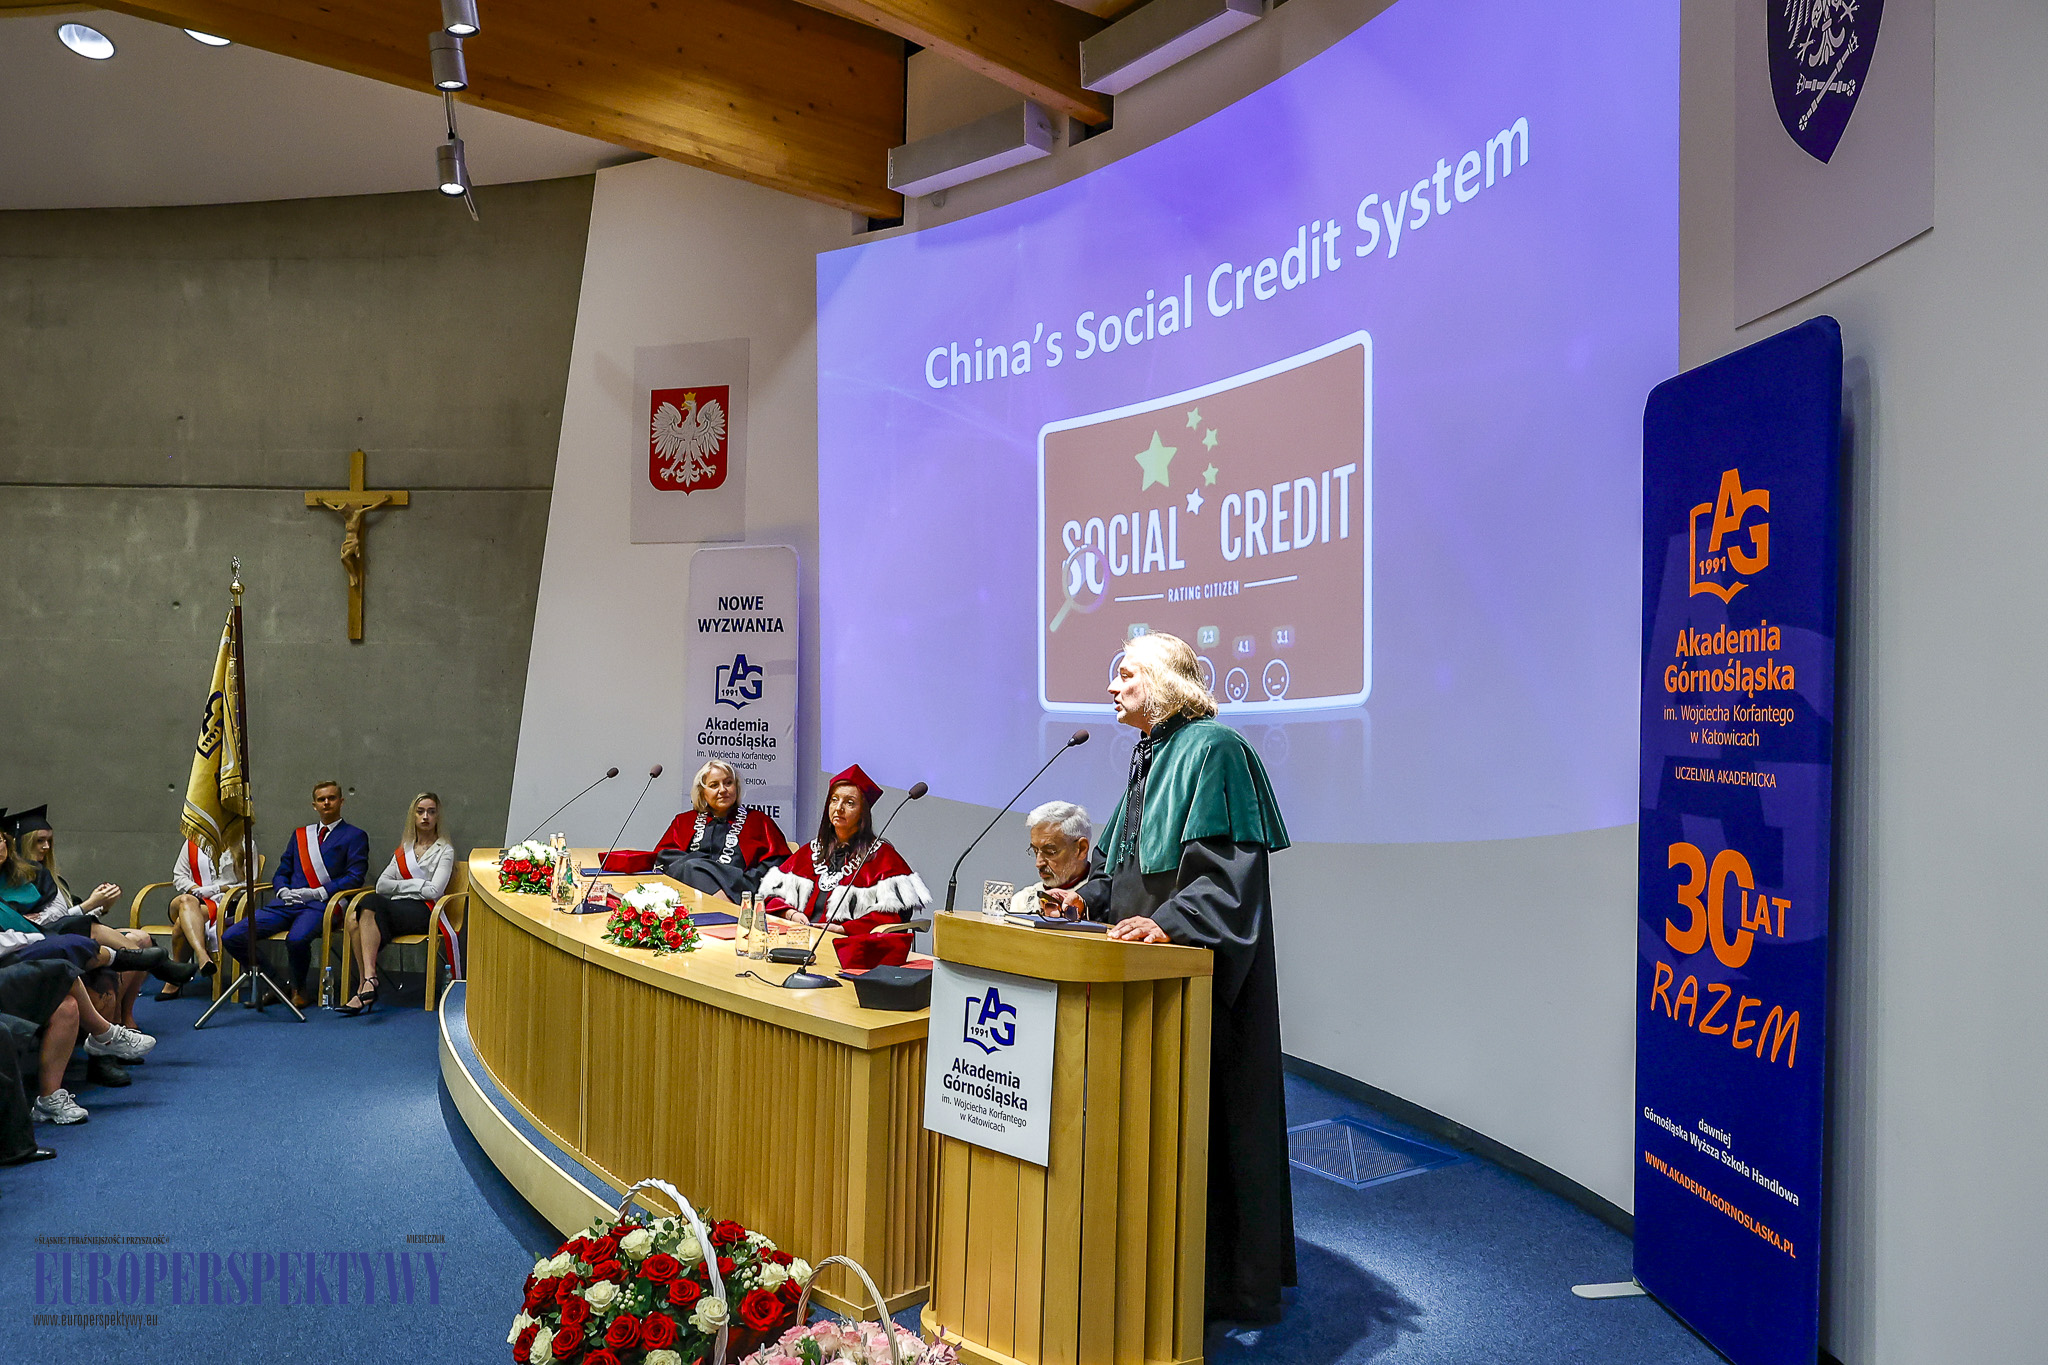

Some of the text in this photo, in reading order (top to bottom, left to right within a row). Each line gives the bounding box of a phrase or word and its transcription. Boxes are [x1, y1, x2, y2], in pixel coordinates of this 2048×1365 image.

[1075, 275, 1193, 360] Social
[1206, 225, 1341, 318] Credit
[1355, 115, 1530, 258] System
[1062, 462, 1356, 594] SOCIAL CREDIT
[1699, 556, 1726, 576] 1991
[1168, 580, 1239, 602] RATING CITIZEN
[718, 596, 764, 611] NOWE
[698, 618, 784, 633] WYZWANIA
[1675, 619, 1781, 658] Akademia
[1664, 657, 1795, 698] Górnośląska
[721, 689, 738, 697] 1991
[705, 717, 769, 732] Akademia
[1663, 704, 1794, 727] im. Wojciecha Korfantego
[697, 731, 777, 750] Górnośląska
[1690, 728, 1759, 747] w Katowicach
[697, 749, 776, 762] im. Wojciecha Korfantego
[1675, 766, 1776, 788] UCZELNIA AKADEMICKA
[1665, 842, 1791, 968] 30 LAT
[1650, 961, 1799, 1069] RAZEM
[970, 1026, 989, 1039] 1991
[952, 1057, 1020, 1090] Akademia
[943, 1073, 1028, 1112] Górnośląska
[941, 1094, 1027, 1128] im. Wojciecha Korfantego
[959, 1113, 1006, 1133] w Katowicach
[1698, 1118, 1732, 1149] dawniej
[1644, 1106, 1799, 1206] Górnośląska Wyższa Szkoła Handlowa
[1645, 1150, 1796, 1259] WWW.AKADEMIAGORNOSLASKA.PL
